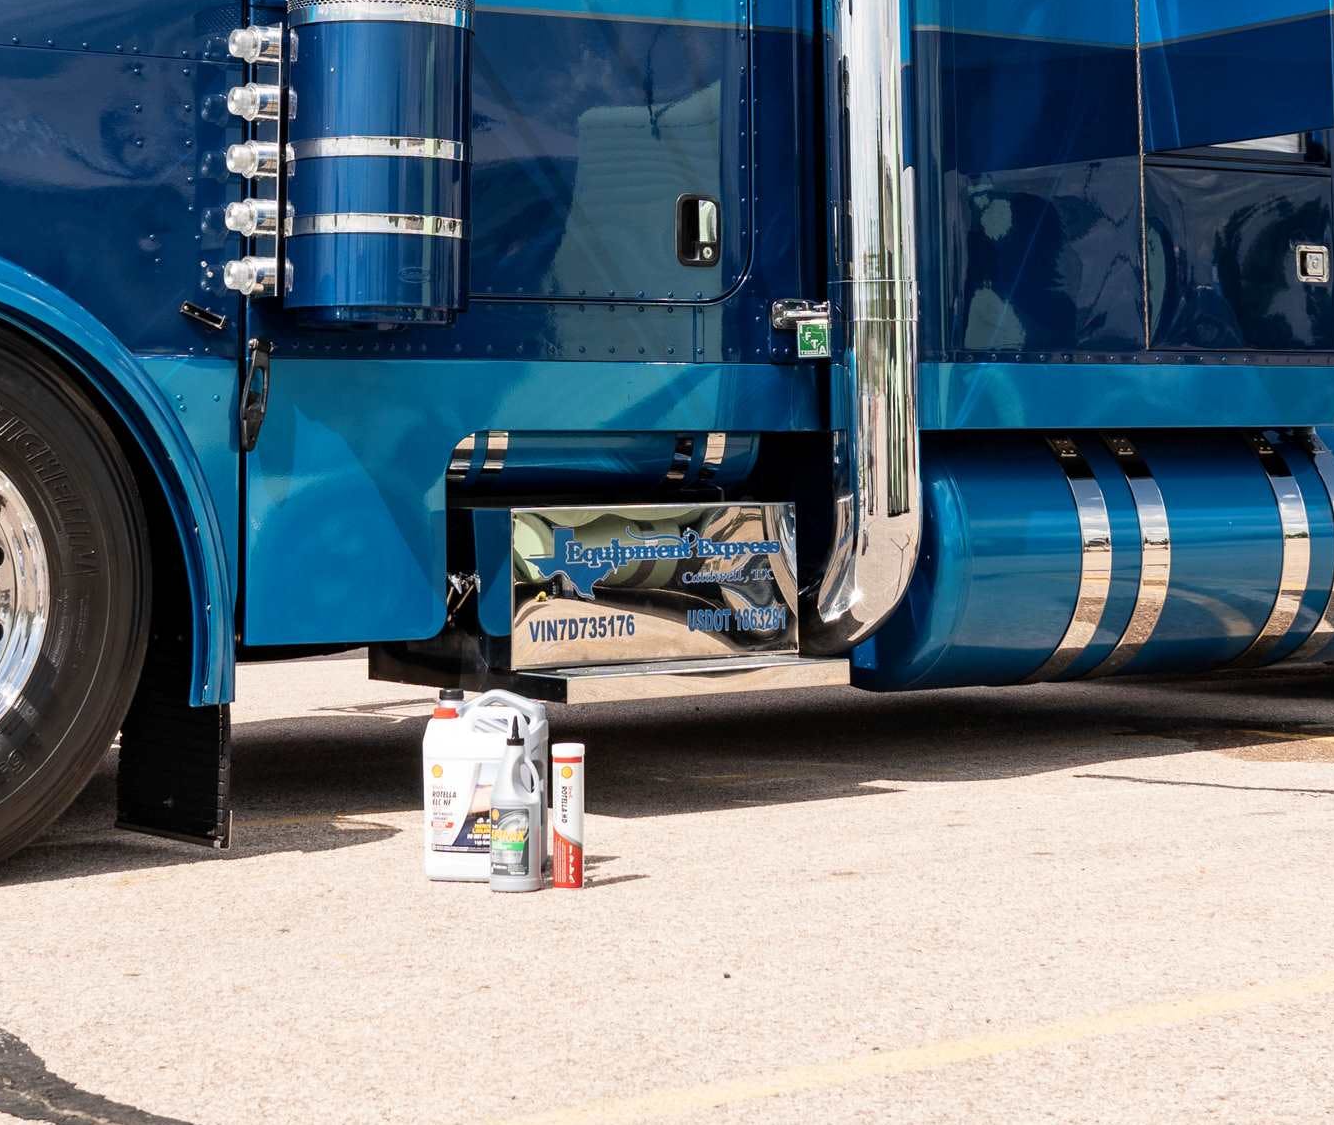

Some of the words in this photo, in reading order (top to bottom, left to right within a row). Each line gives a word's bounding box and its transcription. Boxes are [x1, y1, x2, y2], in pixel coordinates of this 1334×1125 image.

[566, 526, 698, 567] Equipment
[697, 538, 782, 560] Express
[686, 608, 732, 632] USDOT
